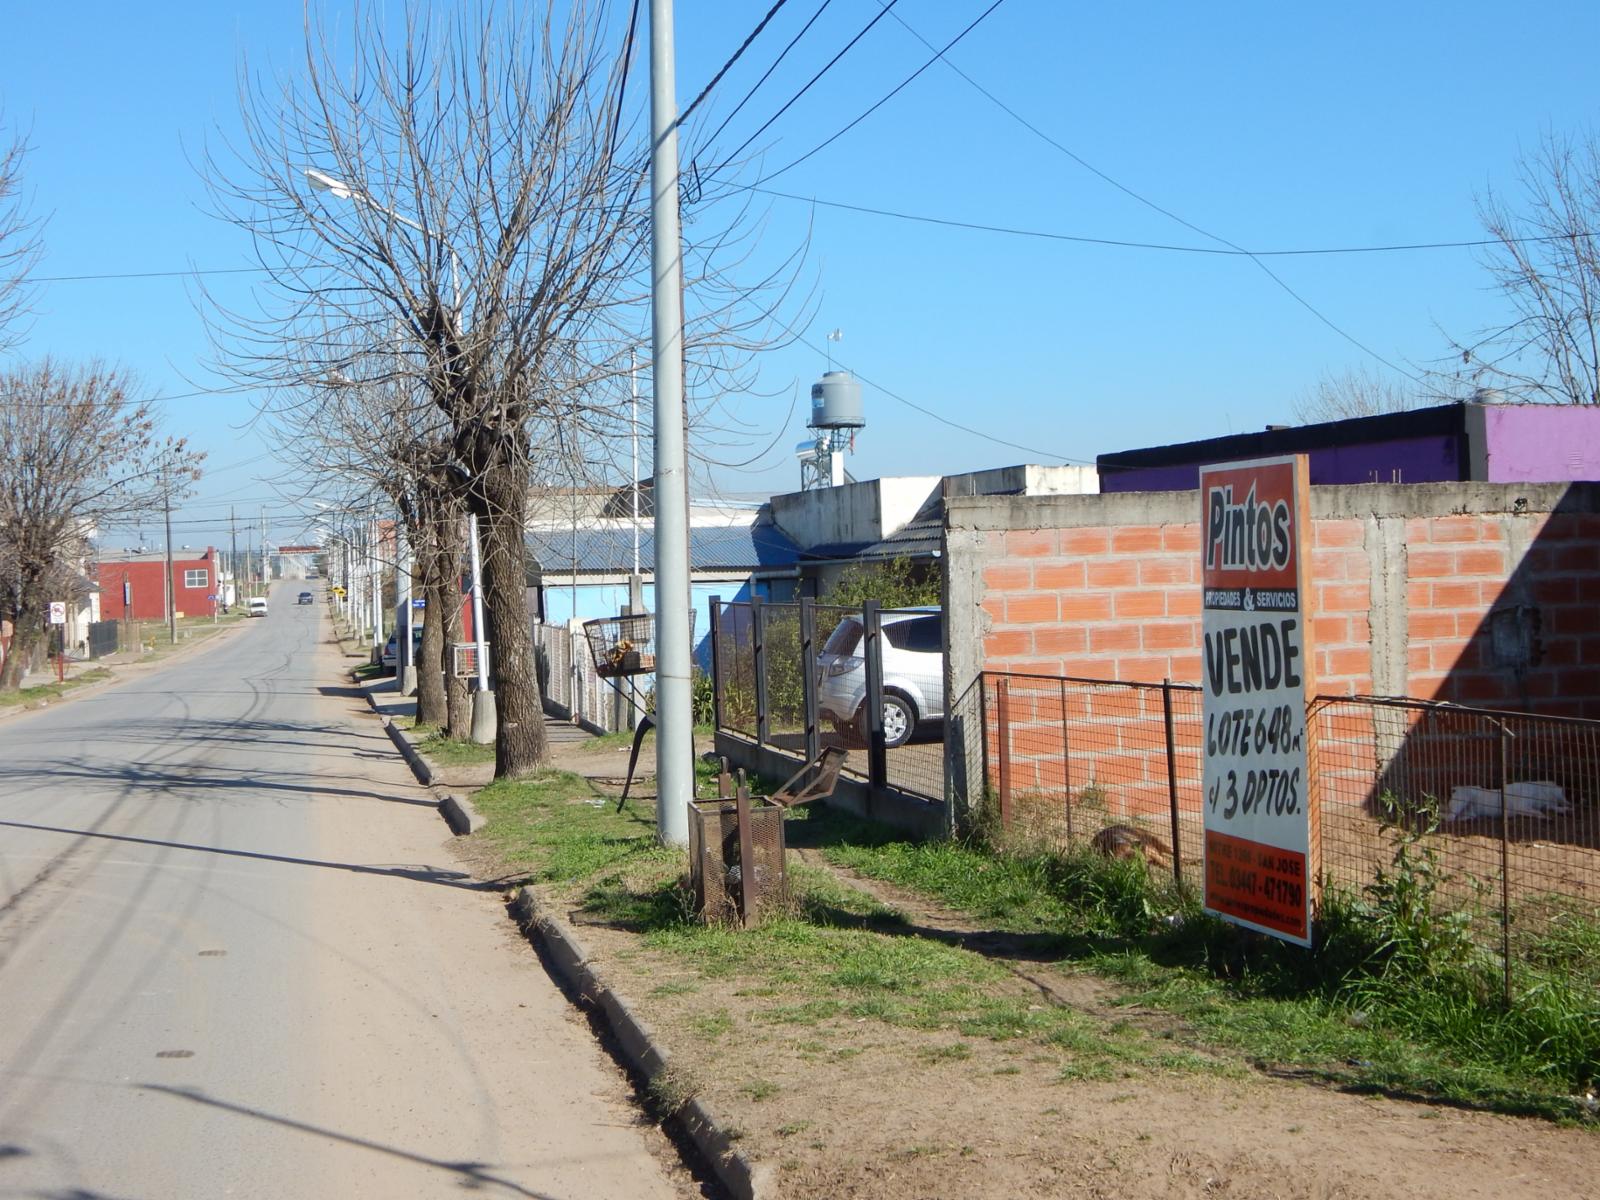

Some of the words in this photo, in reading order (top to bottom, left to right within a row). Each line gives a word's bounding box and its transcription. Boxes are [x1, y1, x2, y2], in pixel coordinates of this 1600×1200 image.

[1206, 478, 1290, 573] Pintos
[1243, 587, 1255, 611] &
[1256, 591, 1296, 608] SERVICIOS
[1205, 619, 1301, 698] VENDE
[1207, 708, 1254, 757] LOTE
